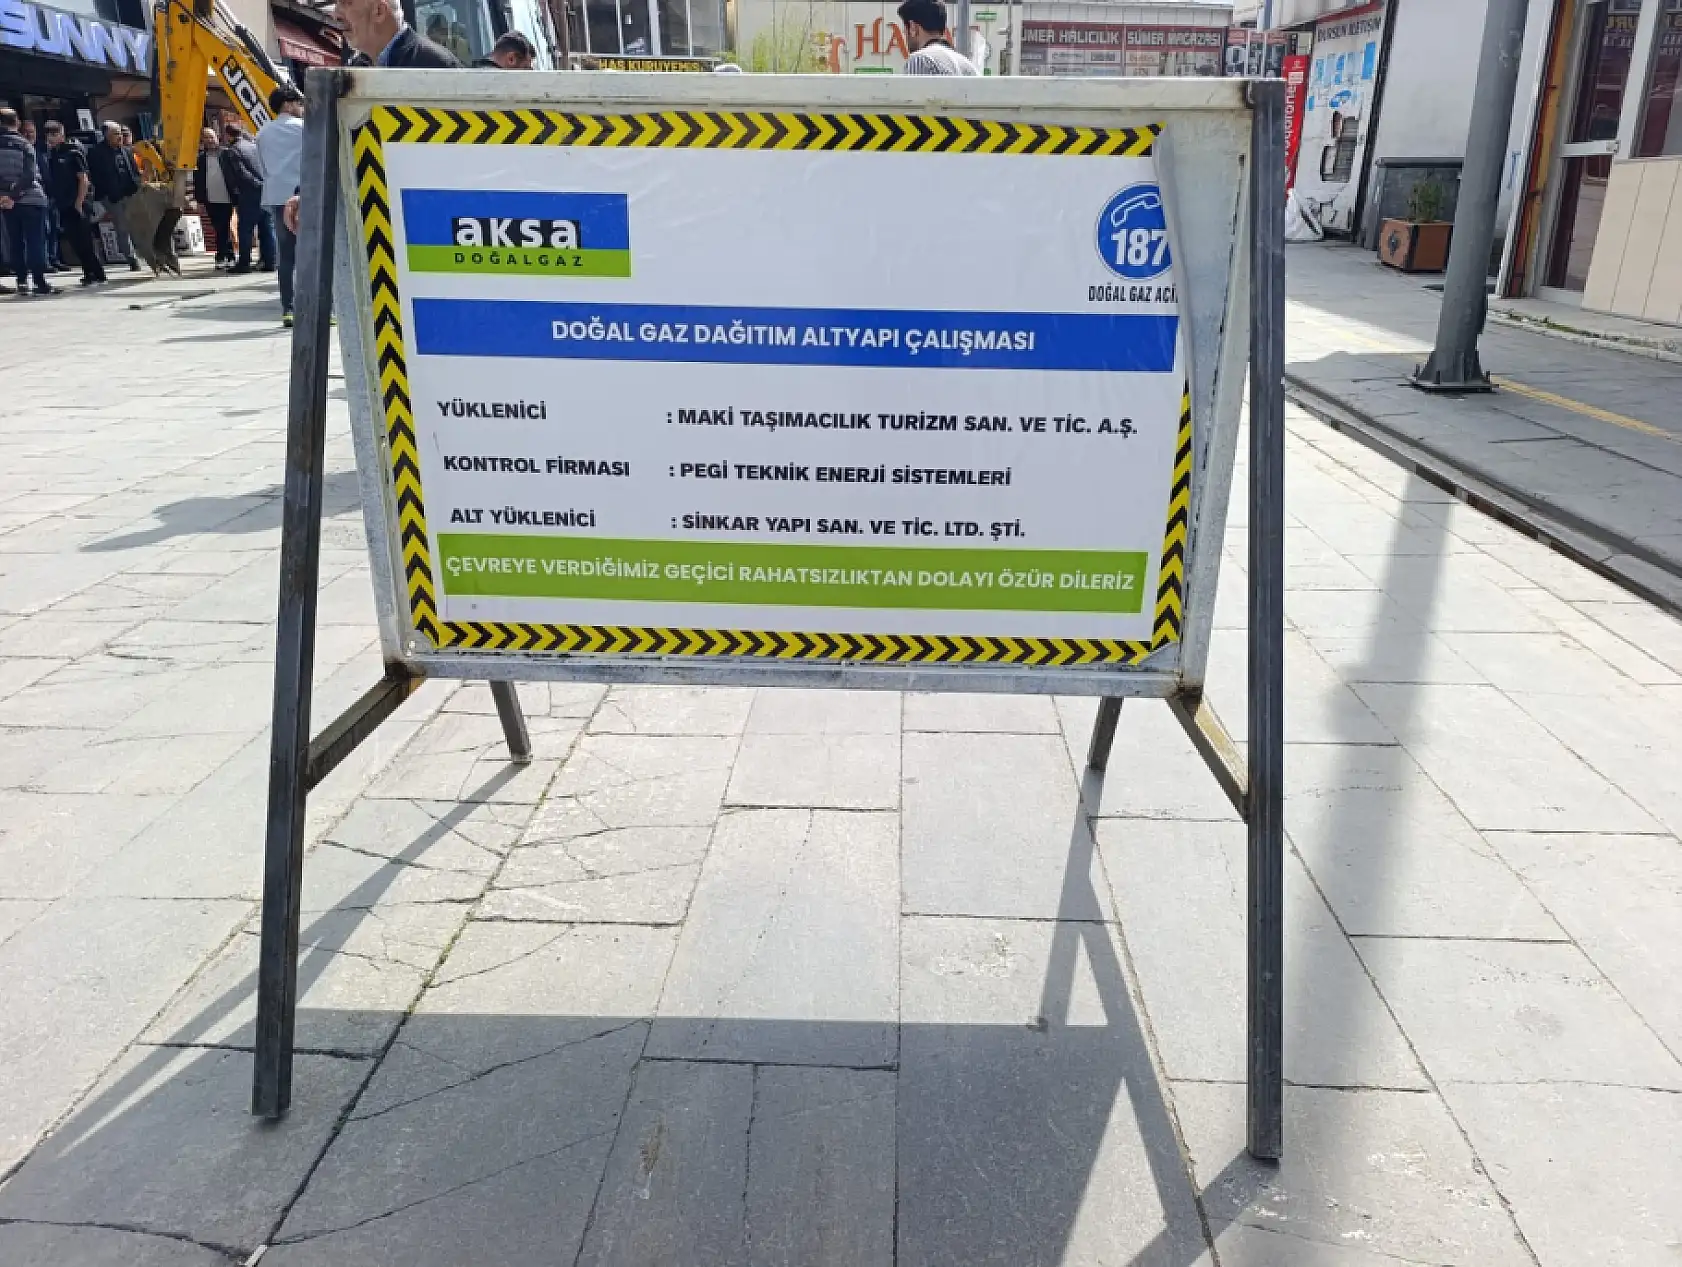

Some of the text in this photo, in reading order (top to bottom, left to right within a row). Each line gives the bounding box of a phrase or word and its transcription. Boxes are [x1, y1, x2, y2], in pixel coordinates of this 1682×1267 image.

[456, 217, 579, 250] aksa
[1111, 228, 1168, 266] 187
[454, 250, 584, 268] DOĞALGAZ
[1088, 281, 1127, 302] DOĞAL
[1129, 286, 1153, 302] GAZ
[551, 317, 1035, 356] DOĞAL GAZ DAĞITIM ALTYAPI ÇALIŞMASI
[437, 397, 547, 420] YÜKLENİCİ
[677, 406, 734, 427] MAKİ
[740, 409, 872, 432] TAŞIMACILIK
[877, 411, 957, 432] TURİZM
[964, 416, 1013, 433] SAN.
[1019, 416, 1047, 434] VE
[1053, 413, 1092, 435] TİC.
[1097, 418, 1138, 439] A.Ş.
[443, 455, 631, 477] KONTROL FİRMASI
[680, 460, 728, 480] PEGİ
[734, 460, 810, 482] TEKNİK
[815, 465, 886, 484] ENERJİ
[891, 464, 1012, 486] SİSTEMLERİ
[450, 506, 596, 528] ALT YÜKLENİCİ
[682, 510, 760, 531] SİNKAR
[766, 515, 811, 534] YAPI
[816, 518, 864, 535] SAN.
[869, 520, 896, 535] VE
[902, 516, 939, 537] TİC.
[944, 521, 984, 537] LTD.
[990, 518, 1026, 541] ŞTİ.
[446, 554, 1136, 591] ÇEVREYE VERDİĞİMİZ GEÇİCİ RAHATSIZLIKTAN DOLAYI ÖZÜR DİLERİZ
